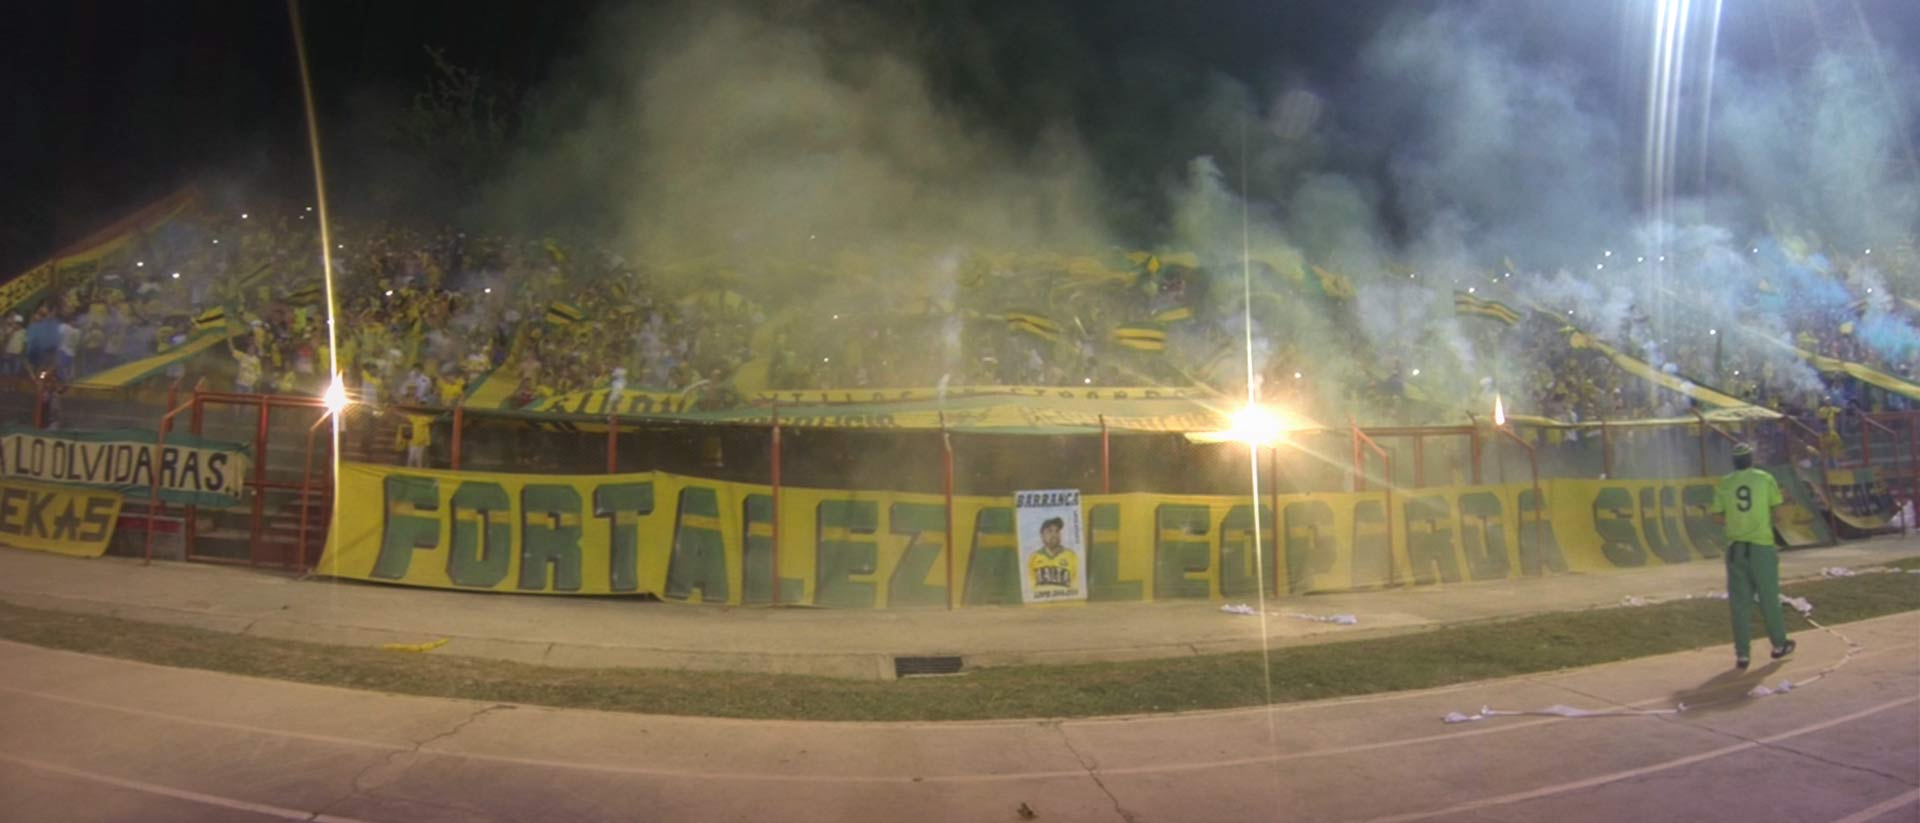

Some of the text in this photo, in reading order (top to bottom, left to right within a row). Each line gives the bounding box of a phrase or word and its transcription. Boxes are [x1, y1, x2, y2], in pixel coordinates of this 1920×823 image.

[15, 436, 45, 477] LO
[1016, 492, 1080, 508] BARRANCA
[1735, 485, 1752, 512] 9
[369, 475, 1729, 608] FORTALEZA LEOPARDA SUR
